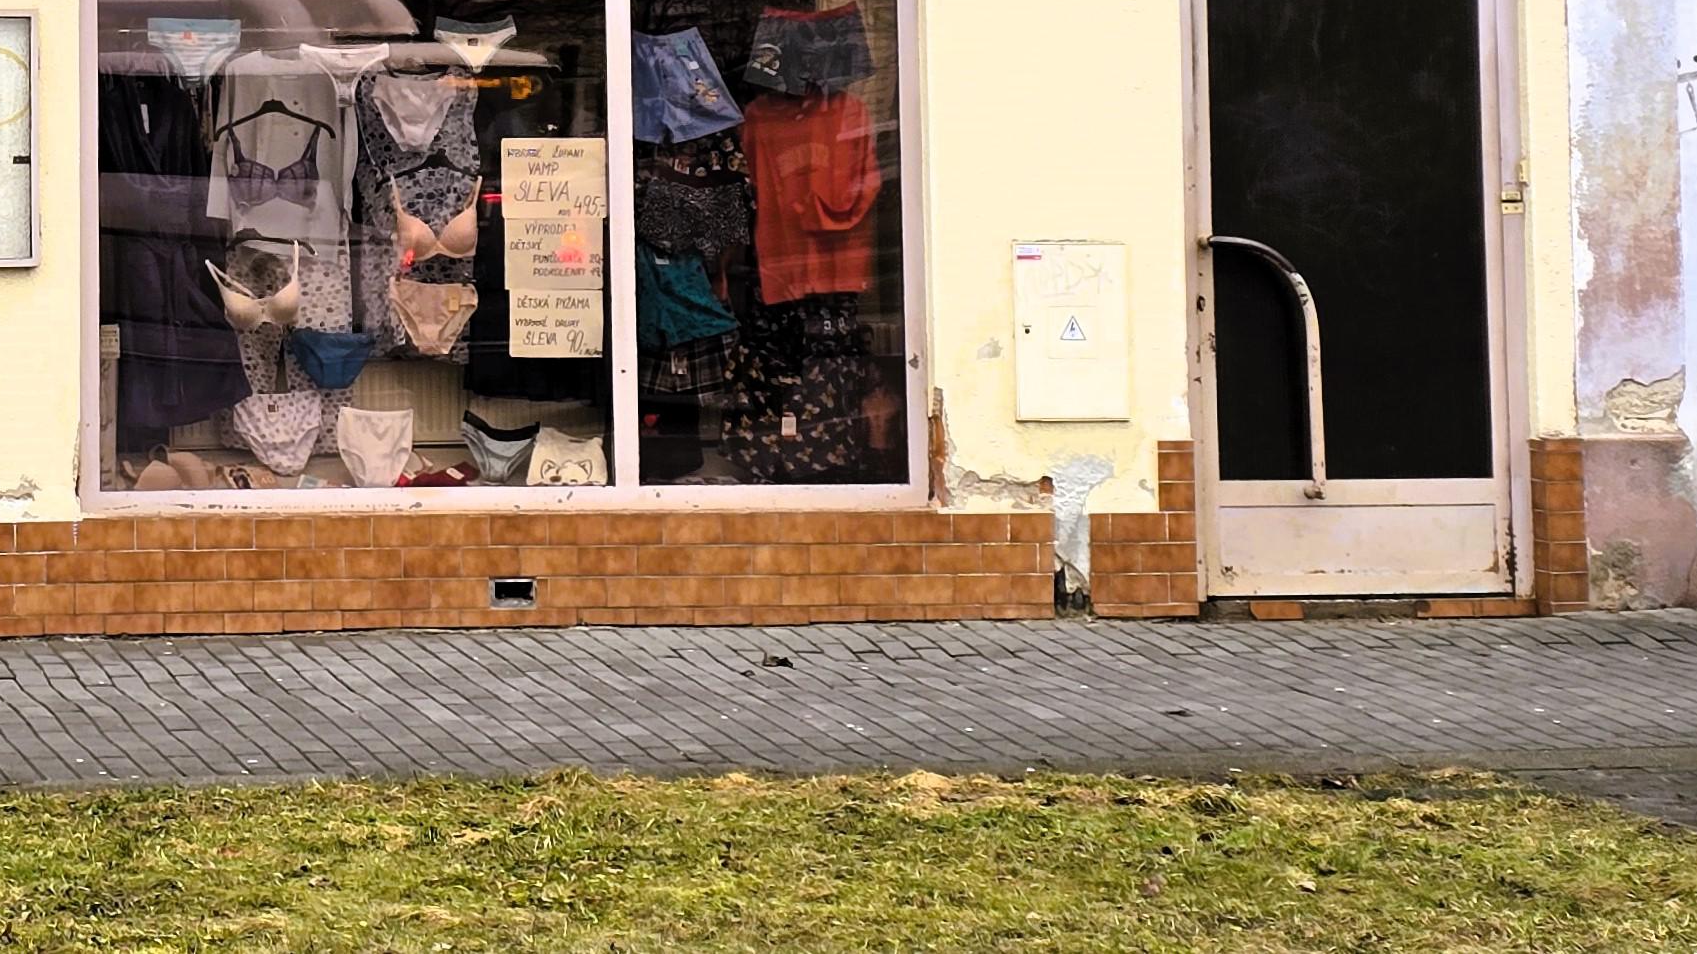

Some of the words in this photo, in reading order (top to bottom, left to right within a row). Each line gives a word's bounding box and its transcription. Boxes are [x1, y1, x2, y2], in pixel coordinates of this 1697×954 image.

[528, 162, 559, 176] VAMP
[514, 180, 570, 202] SLEVA
[523, 331, 557, 346] SLEVA
